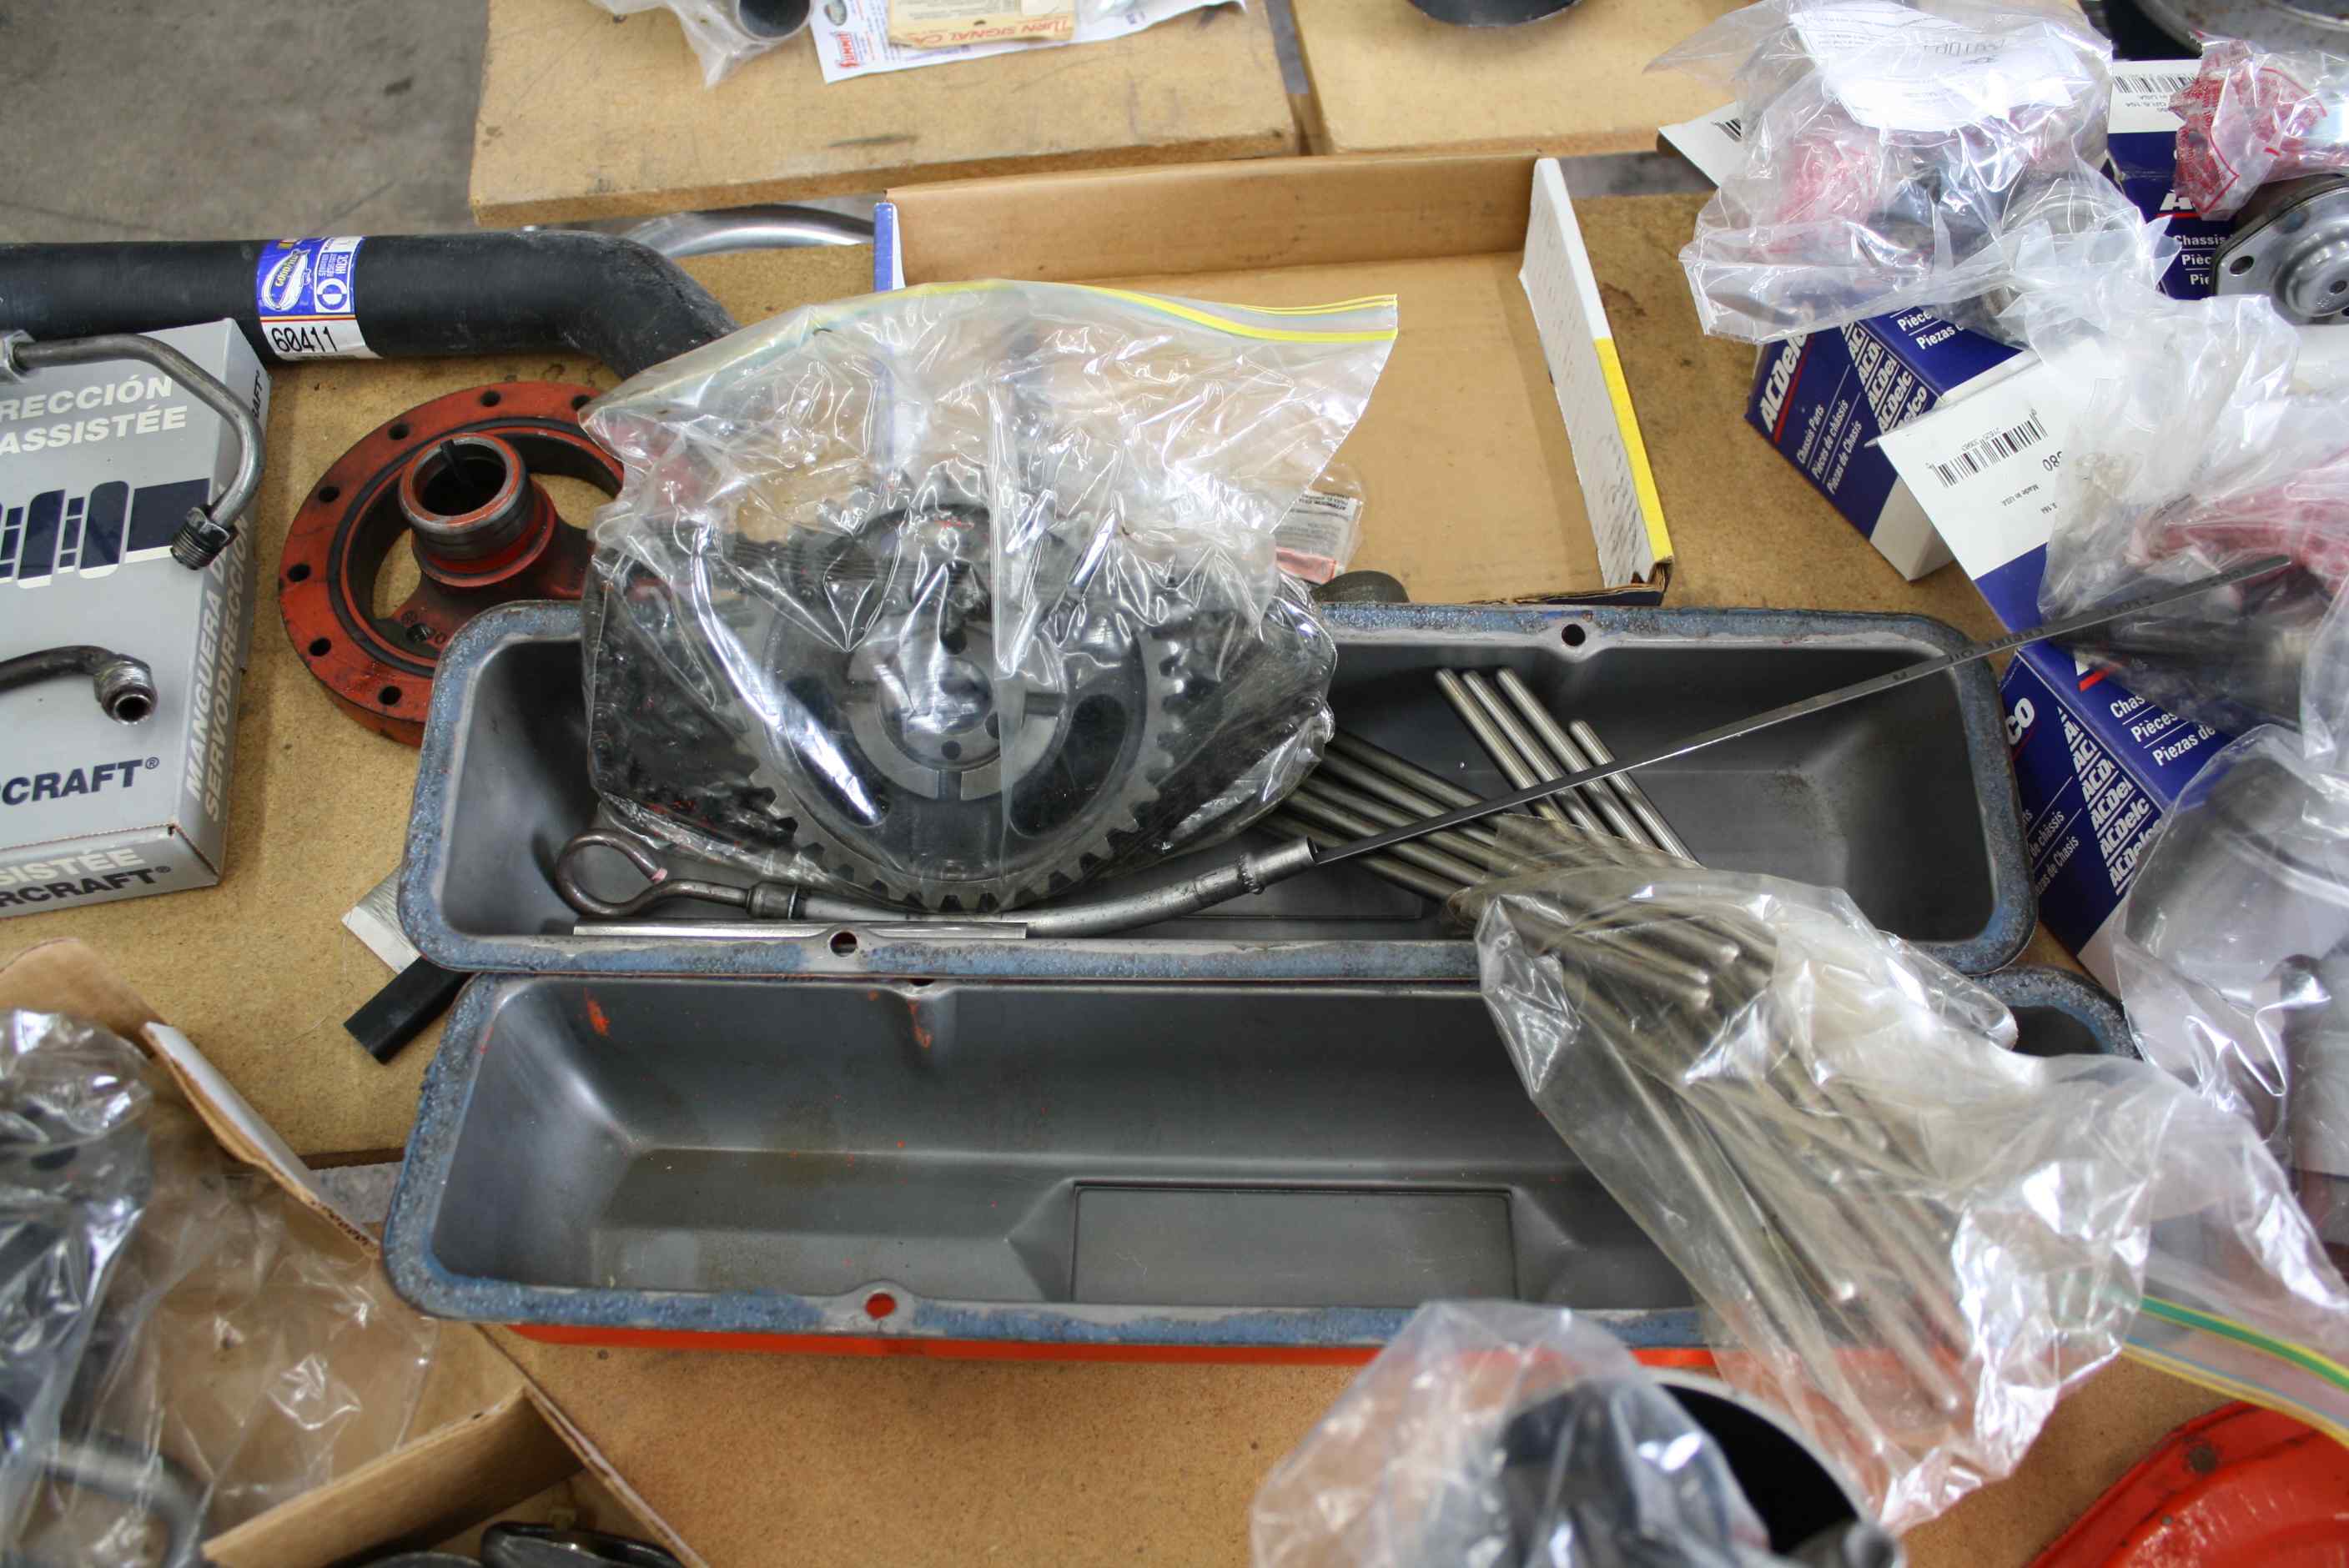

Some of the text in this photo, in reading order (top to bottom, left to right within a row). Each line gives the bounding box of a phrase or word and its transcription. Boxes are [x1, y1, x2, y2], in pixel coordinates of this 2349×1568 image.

[271, 326, 338, 353] 60411
[1915, 326, 1955, 349] Piezas
[0, 404, 188, 455] ASSISTÉE
[1796, 403, 1824, 465] Chassis Parts
[1811, 399, 1849, 480] Pièces de châssis
[1826, 420, 1863, 495] Piezas de Chasis
[186, 589, 222, 802] MANGUERA
[2151, 733, 2199, 767] Piezas
[0, 756, 159, 806] CRAFT®
[2053, 834, 2080, 867] Chasis
